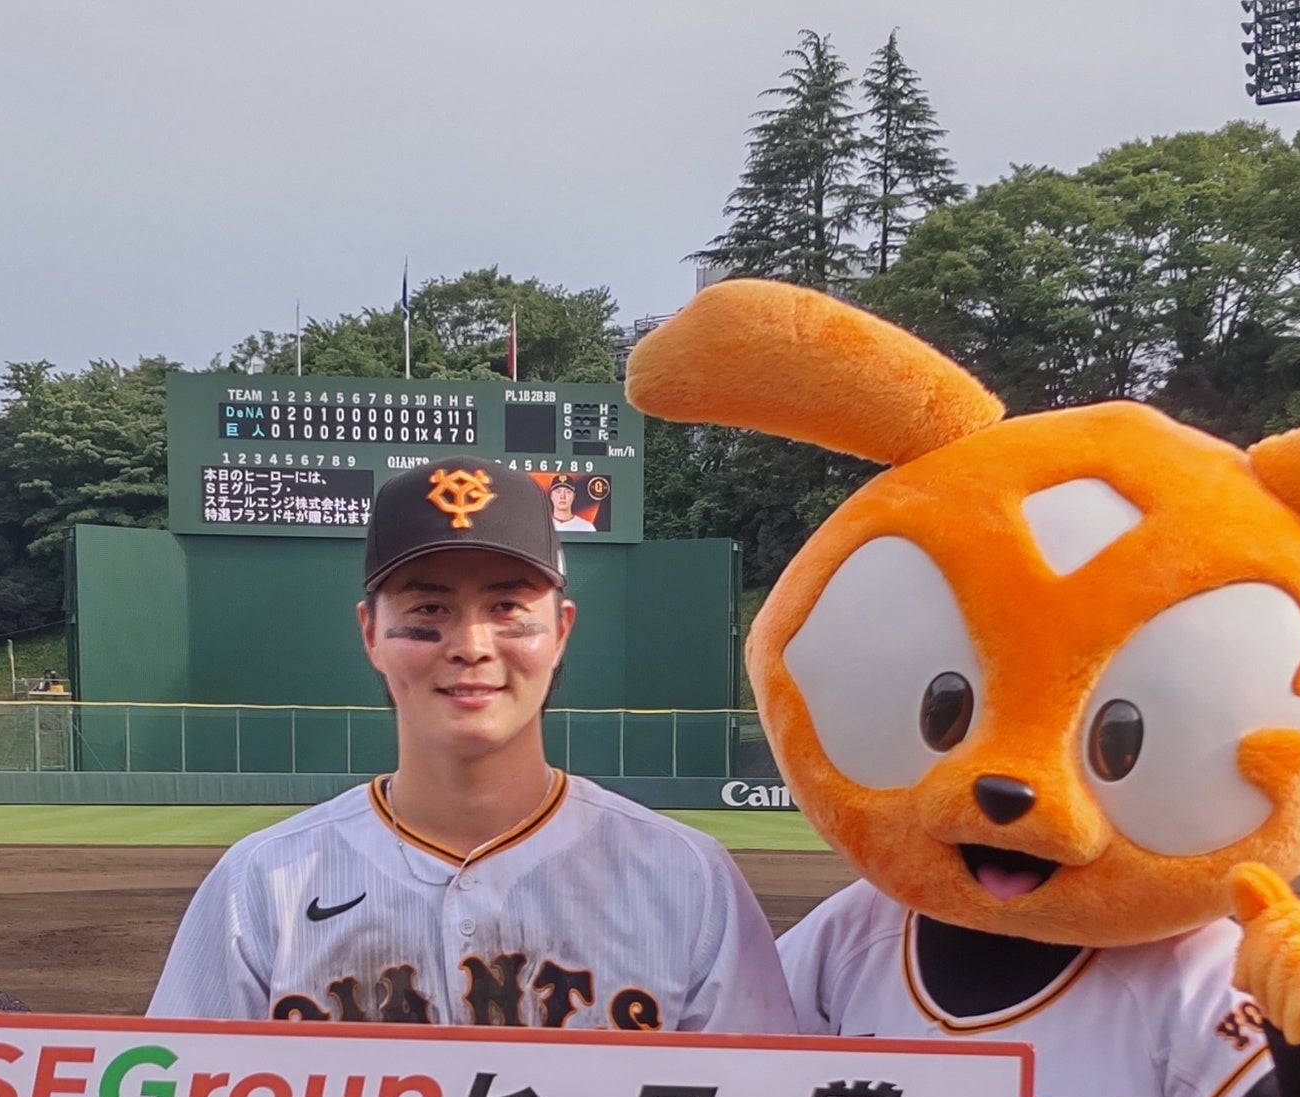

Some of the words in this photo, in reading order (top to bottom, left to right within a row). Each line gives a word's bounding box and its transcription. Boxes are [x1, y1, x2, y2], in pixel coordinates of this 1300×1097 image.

[228, 389, 262, 401] TEAM
[271, 391, 279, 401] 1
[288, 391, 296, 402] 2
[304, 392, 312, 402] 3
[320, 392, 328, 403] 4
[336, 392, 344, 404] 5
[352, 393, 360, 404] 6
[368, 393, 376, 404] 7
[384, 394, 392, 404] 8
[400, 394, 408, 405] 9
[415, 395, 426, 405] 10
[433, 395, 442, 406] R
[449, 395, 458, 406] H
[466, 396, 474, 407] E
[505, 390, 517, 401] PL
[519, 390, 530, 401] 1B
[531, 391, 543, 402] 2B
[544, 391, 556, 402] 3B
[226, 406, 264, 419] DeNA
[271, 406, 280, 420] 0
[288, 406, 296, 421] 2
[304, 407, 312, 421] 0
[321, 407, 327, 421] 1
[336, 408, 344, 422] 0
[352, 408, 360, 422] 0
[369, 409, 377, 423] 0
[384, 409, 393, 423] 0
[400, 409, 409, 424] 0
[416, 410, 425, 424] 0
[433, 410, 442, 424] 3
[448, 410, 459, 425] 11
[467, 411, 472, 425] 1
[564, 403, 572, 414] B
[600, 404, 608, 415] H
[564, 416, 572, 427] S
[600, 417, 608, 428] E
[271, 424, 280, 438] 0
[290, 424, 295, 438] 1
[304, 424, 312, 439] 0
[320, 425, 328, 439] 0
[336, 425, 345, 440] 2
[352, 426, 361, 440] 0
[369, 426, 377, 440] 0
[384, 426, 393, 441] 0
[400, 427, 409, 441] 0
[433, 428, 442, 442] 4
[449, 428, 458, 442] 7
[466, 428, 474, 443] 0
[608, 446, 635, 457] km/h
[223, 453, 230, 464] 1
[238, 453, 247, 464] 2
[254, 453, 262, 465] 3
[269, 454, 278, 465] 4
[285, 454, 293, 465] 5
[300, 454, 309, 466] 6
[316, 455, 325, 466] 7
[332, 456, 340, 467] 8
[348, 456, 356, 467] 9
[509, 460, 517, 471] 4
[525, 461, 532, 471] 5
[540, 461, 548, 472] 6
[555, 461, 563, 472] 7
[570, 462, 578, 472] 8
[585, 462, 593, 473] 9
[203, 468, 327, 485] 本日のヒーローには、
[721, 781, 797, 807] Can
